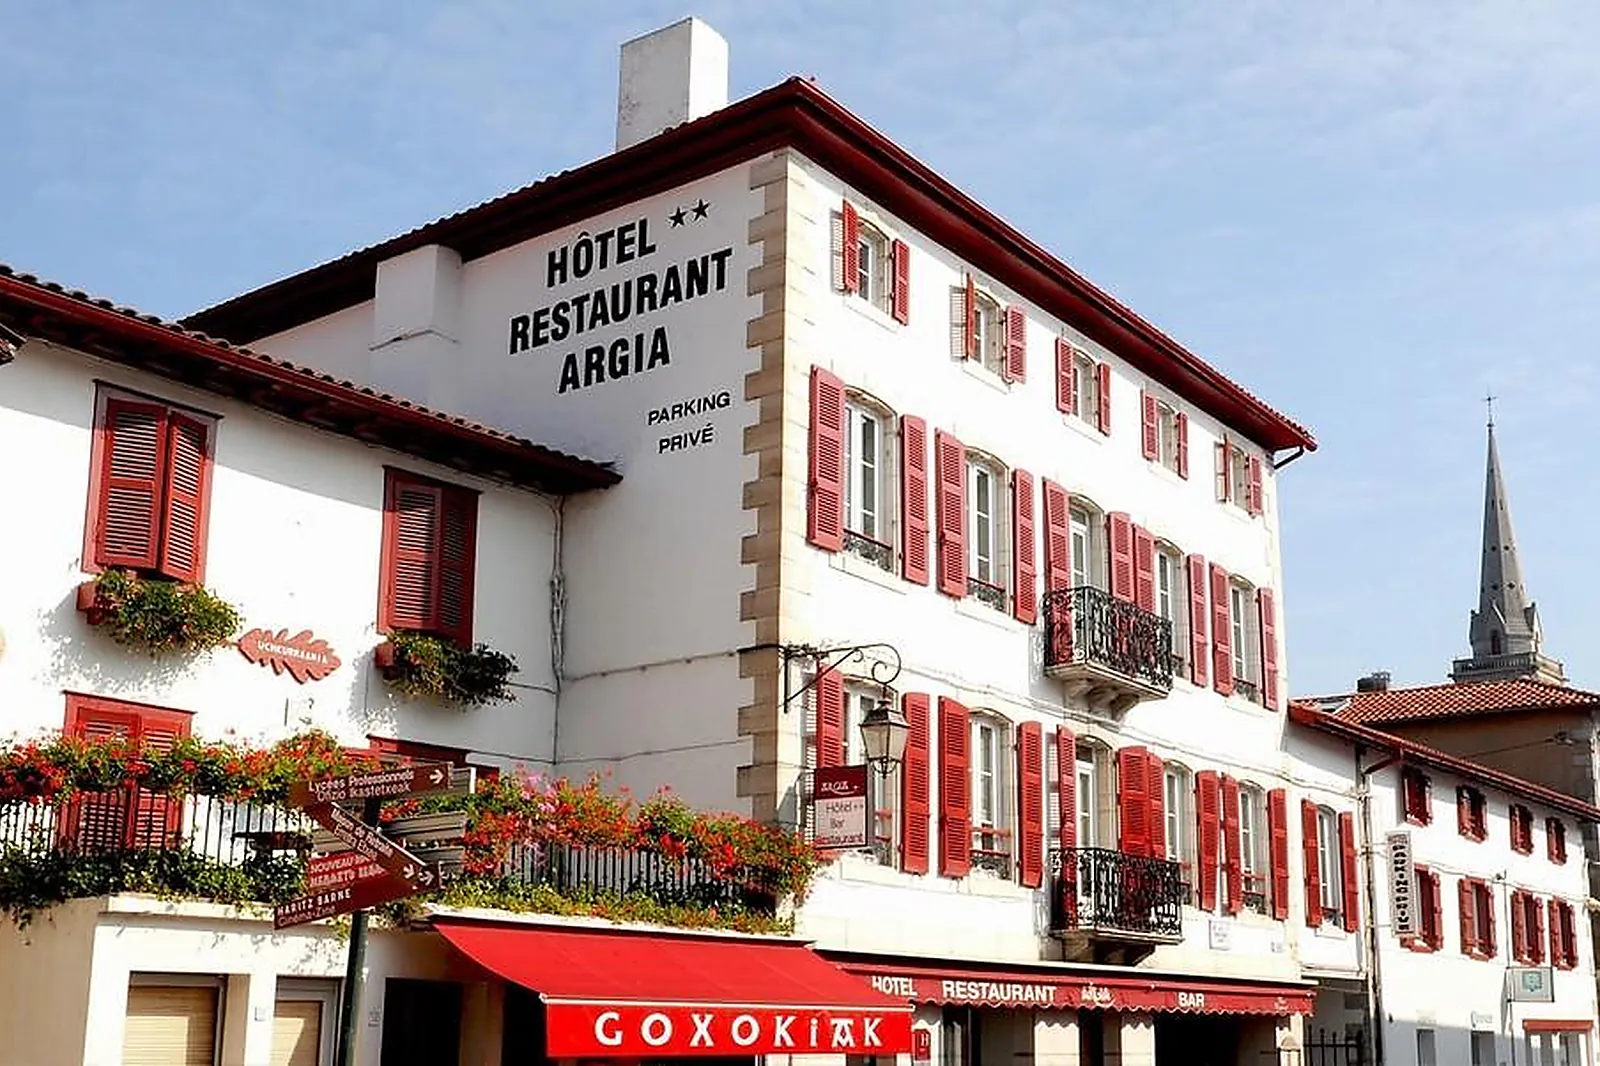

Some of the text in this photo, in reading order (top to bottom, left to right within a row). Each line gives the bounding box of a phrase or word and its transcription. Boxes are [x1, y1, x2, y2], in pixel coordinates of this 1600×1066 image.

[547, 218, 656, 288] HÔTEL
[509, 248, 733, 355] RESTAURANT
[558, 327, 670, 394] ARGIA
[647, 392, 731, 425] PARKING
[658, 423, 714, 454] PRIVÉ
[871, 975, 918, 997] HOTEL
[941, 980, 1058, 1003] RESTAURANT
[1178, 991, 1205, 1008] BAR
